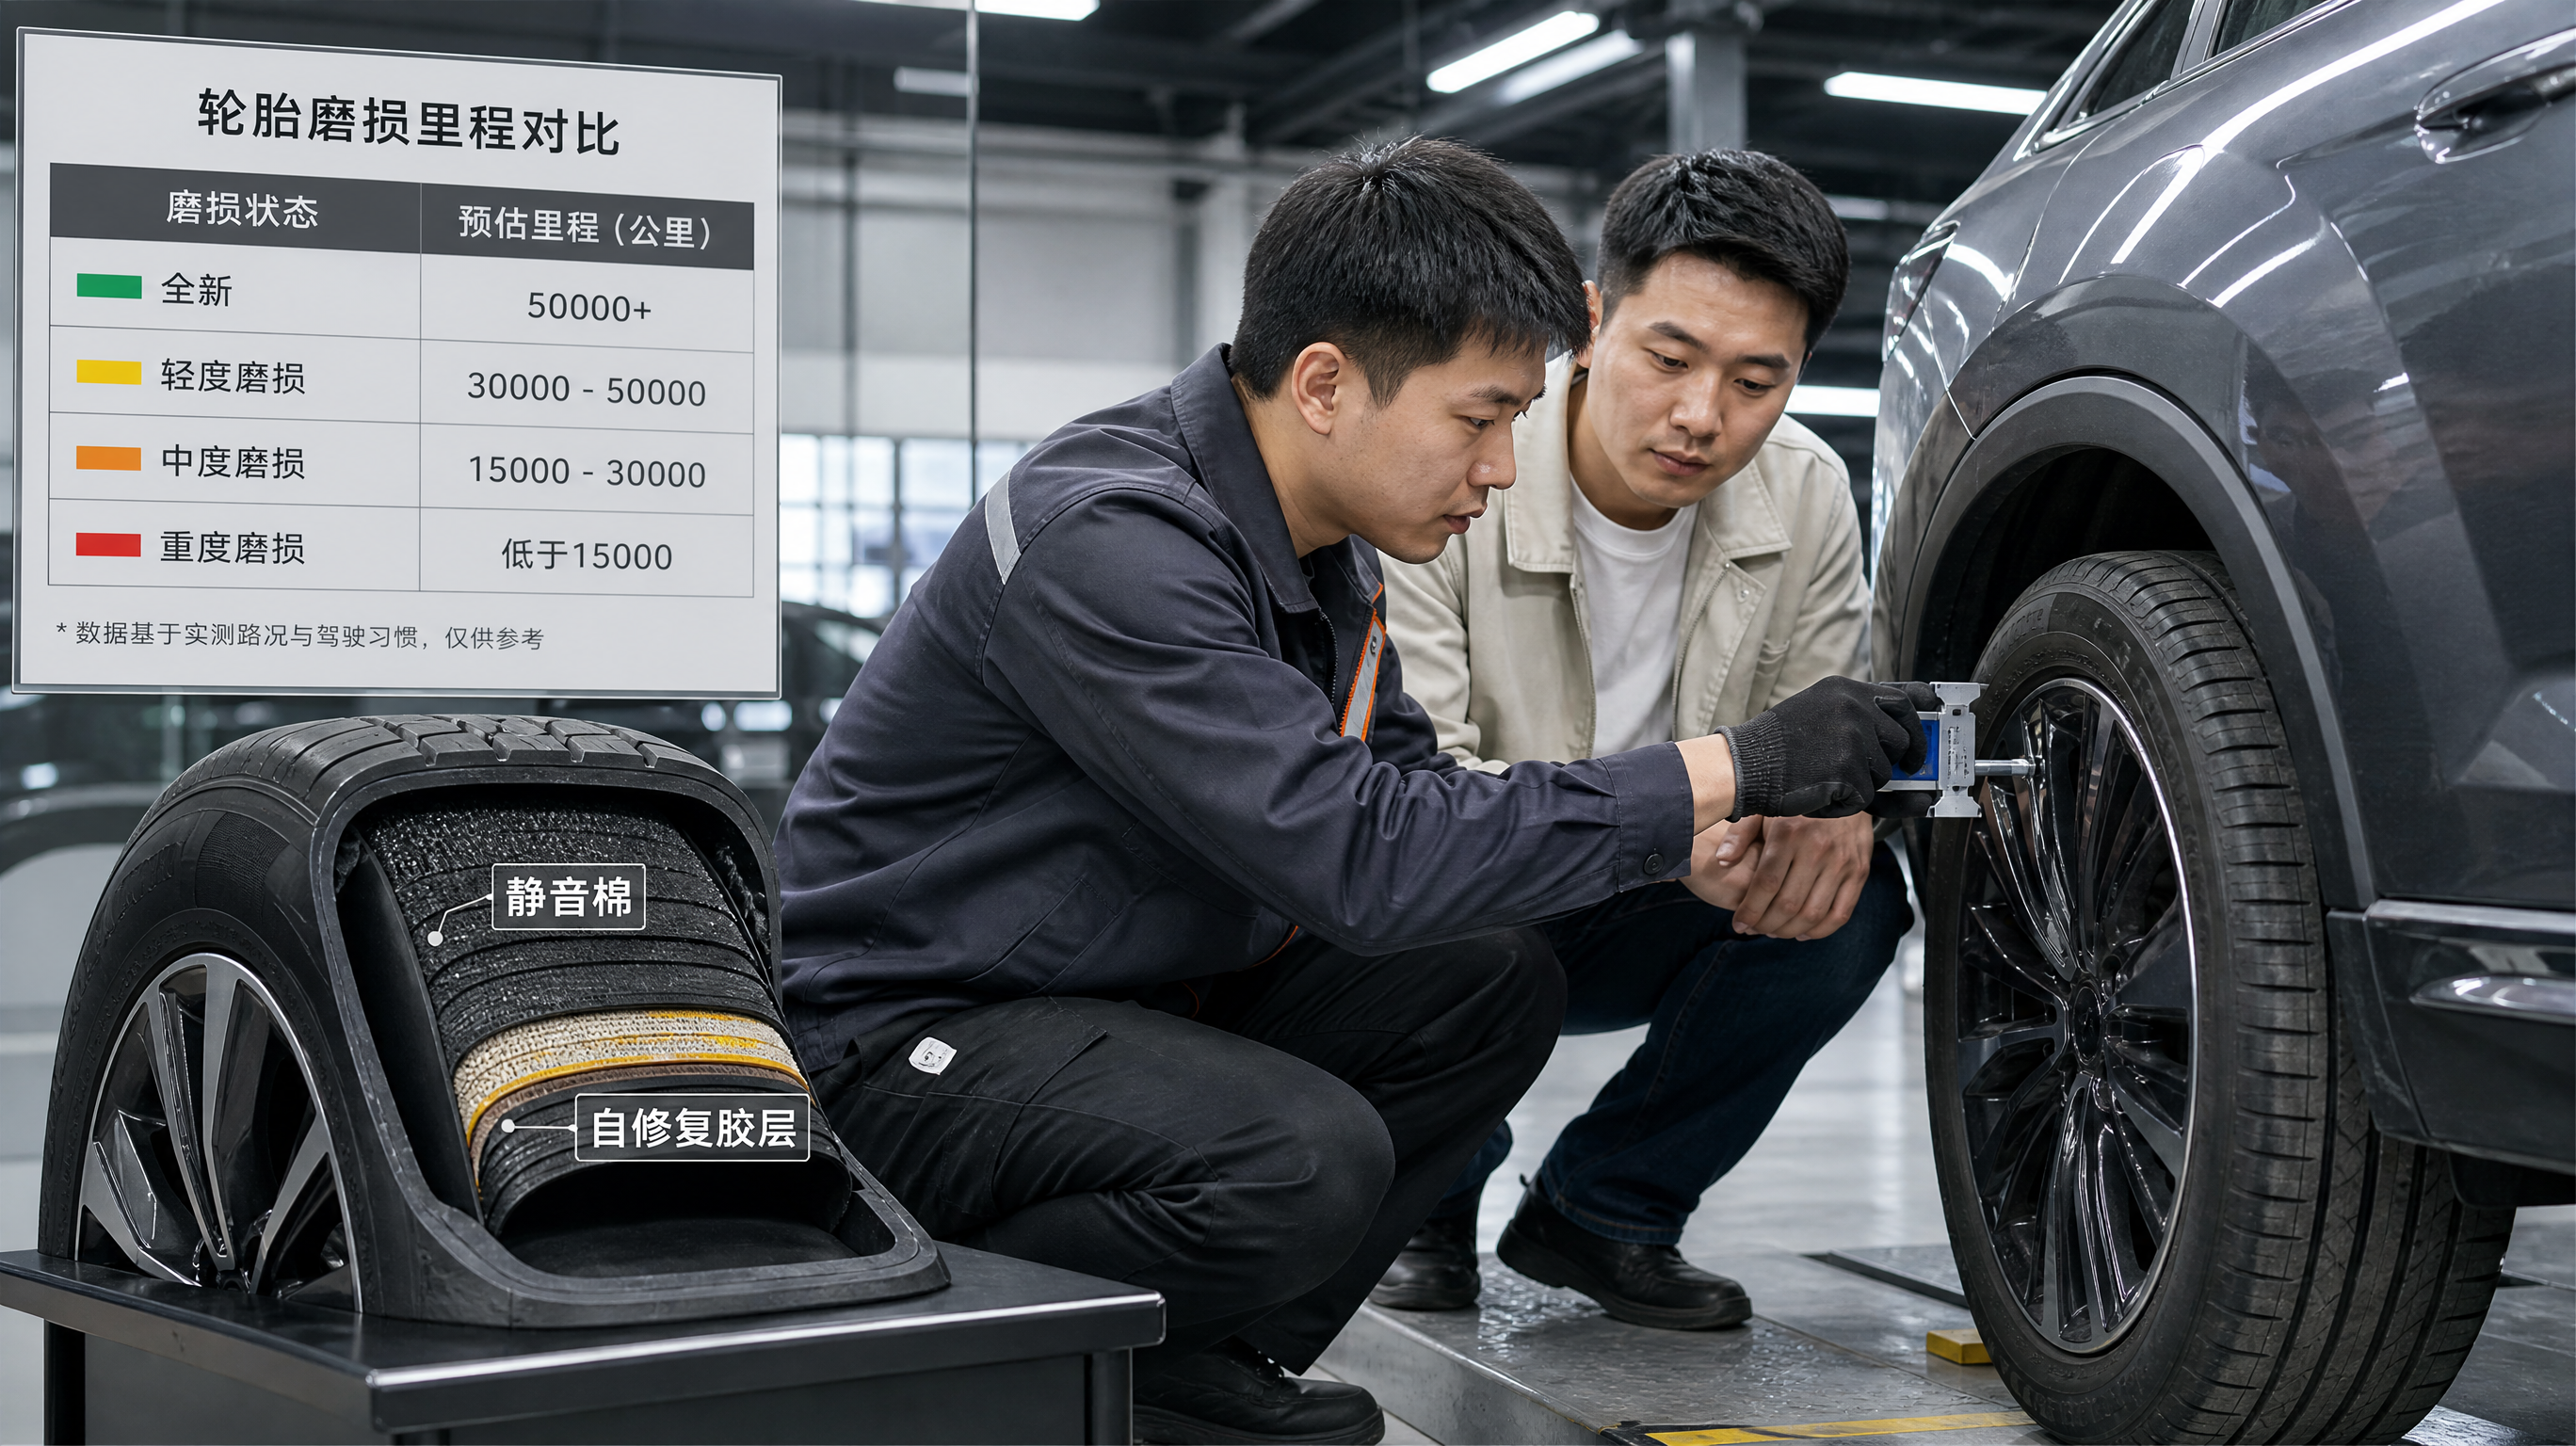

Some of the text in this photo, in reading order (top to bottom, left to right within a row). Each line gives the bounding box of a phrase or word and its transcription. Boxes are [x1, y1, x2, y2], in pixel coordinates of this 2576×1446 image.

[198, 87, 620, 156] 轮胎磨损里程对比
[166, 188, 319, 230] 磨损状态
[161, 271, 233, 308] 全新
[527, 292, 652, 323] 50000+
[160, 357, 306, 395] 轻度磨损
[467, 372, 571, 403] 30000
[606, 377, 706, 408] 50000
[161, 443, 306, 481] 中度磨损
[469, 455, 571, 485] 15000
[606, 458, 706, 489] 30000
[160, 530, 306, 566] 重度磨损
[501, 538, 673, 571] 低于15000
[75, 620, 545, 651] 数据基于实测路况与驾驶习惯，仅供参考
